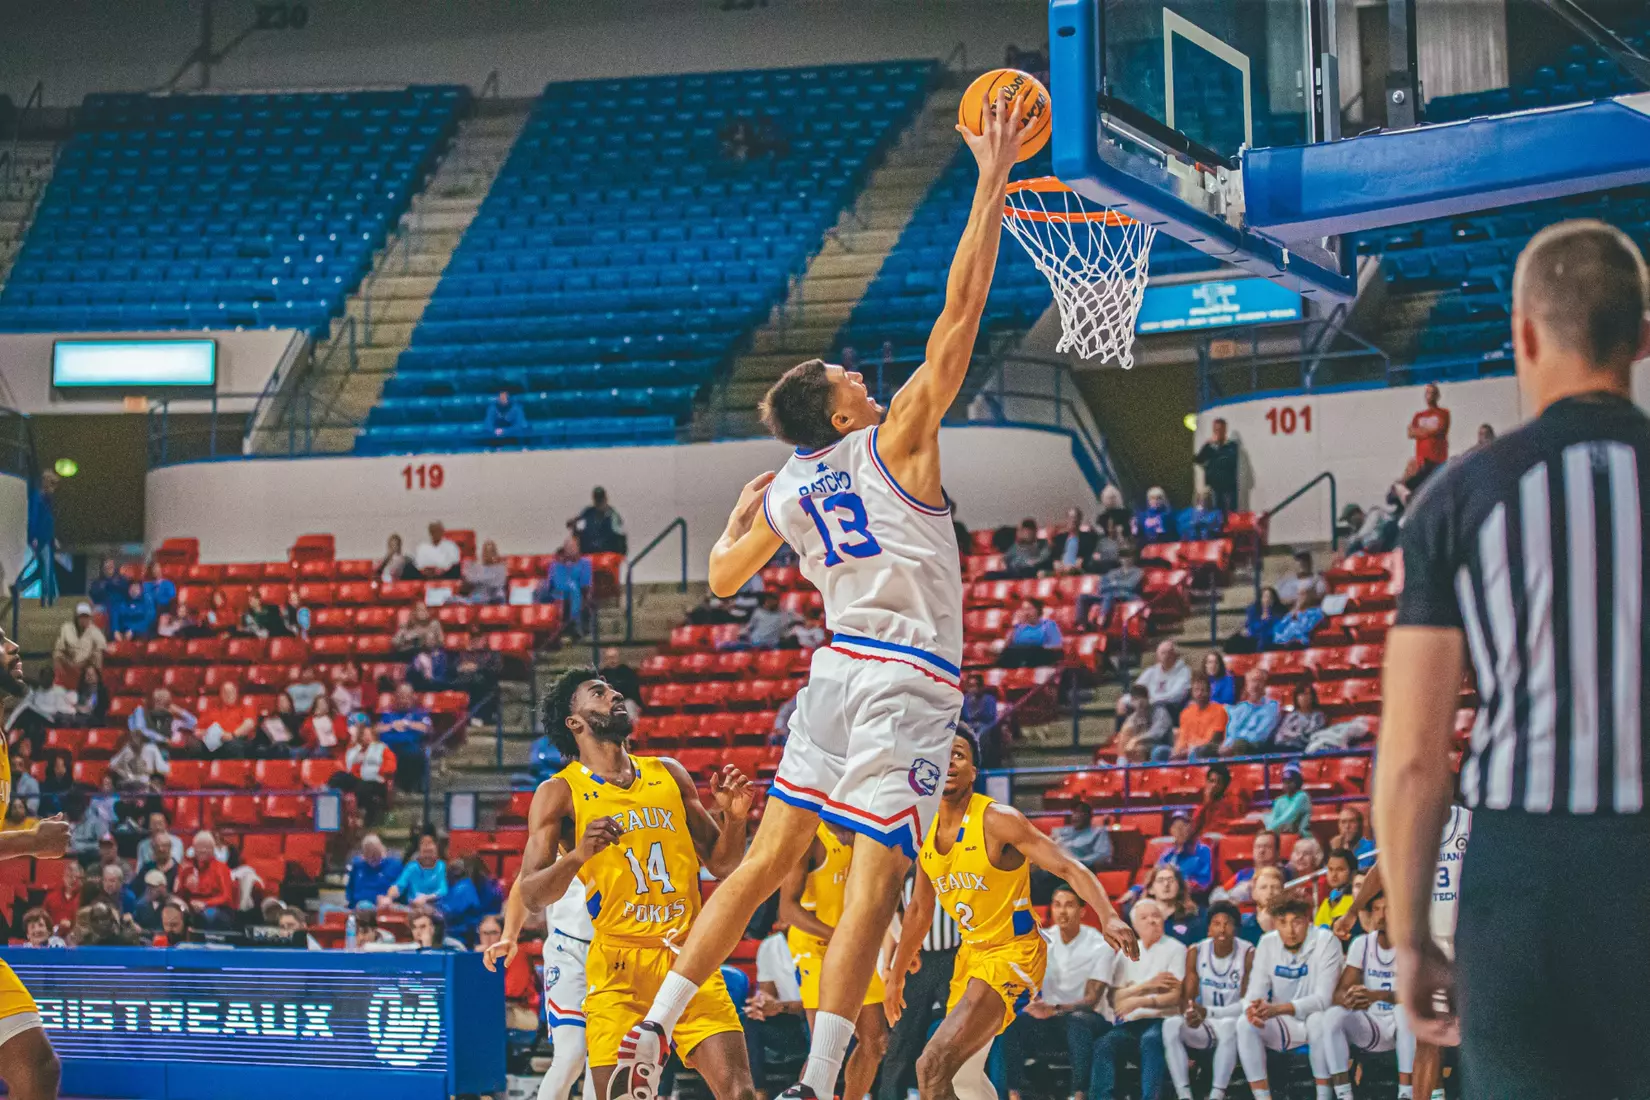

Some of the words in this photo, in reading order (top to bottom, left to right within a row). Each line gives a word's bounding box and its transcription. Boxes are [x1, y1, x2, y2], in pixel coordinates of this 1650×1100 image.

[1265, 405, 1311, 435] 101
[402, 463, 444, 490] 119
[799, 491, 883, 568] 13
[611, 806, 676, 833] EAUX
[624, 841, 676, 895] 14
[1436, 866, 1450, 888] 3
[622, 898, 686, 923] POKES
[1432, 891, 1458, 902] TECH
[955, 901, 978, 932] 2
[33, 999, 334, 1037] BISTREAUX
